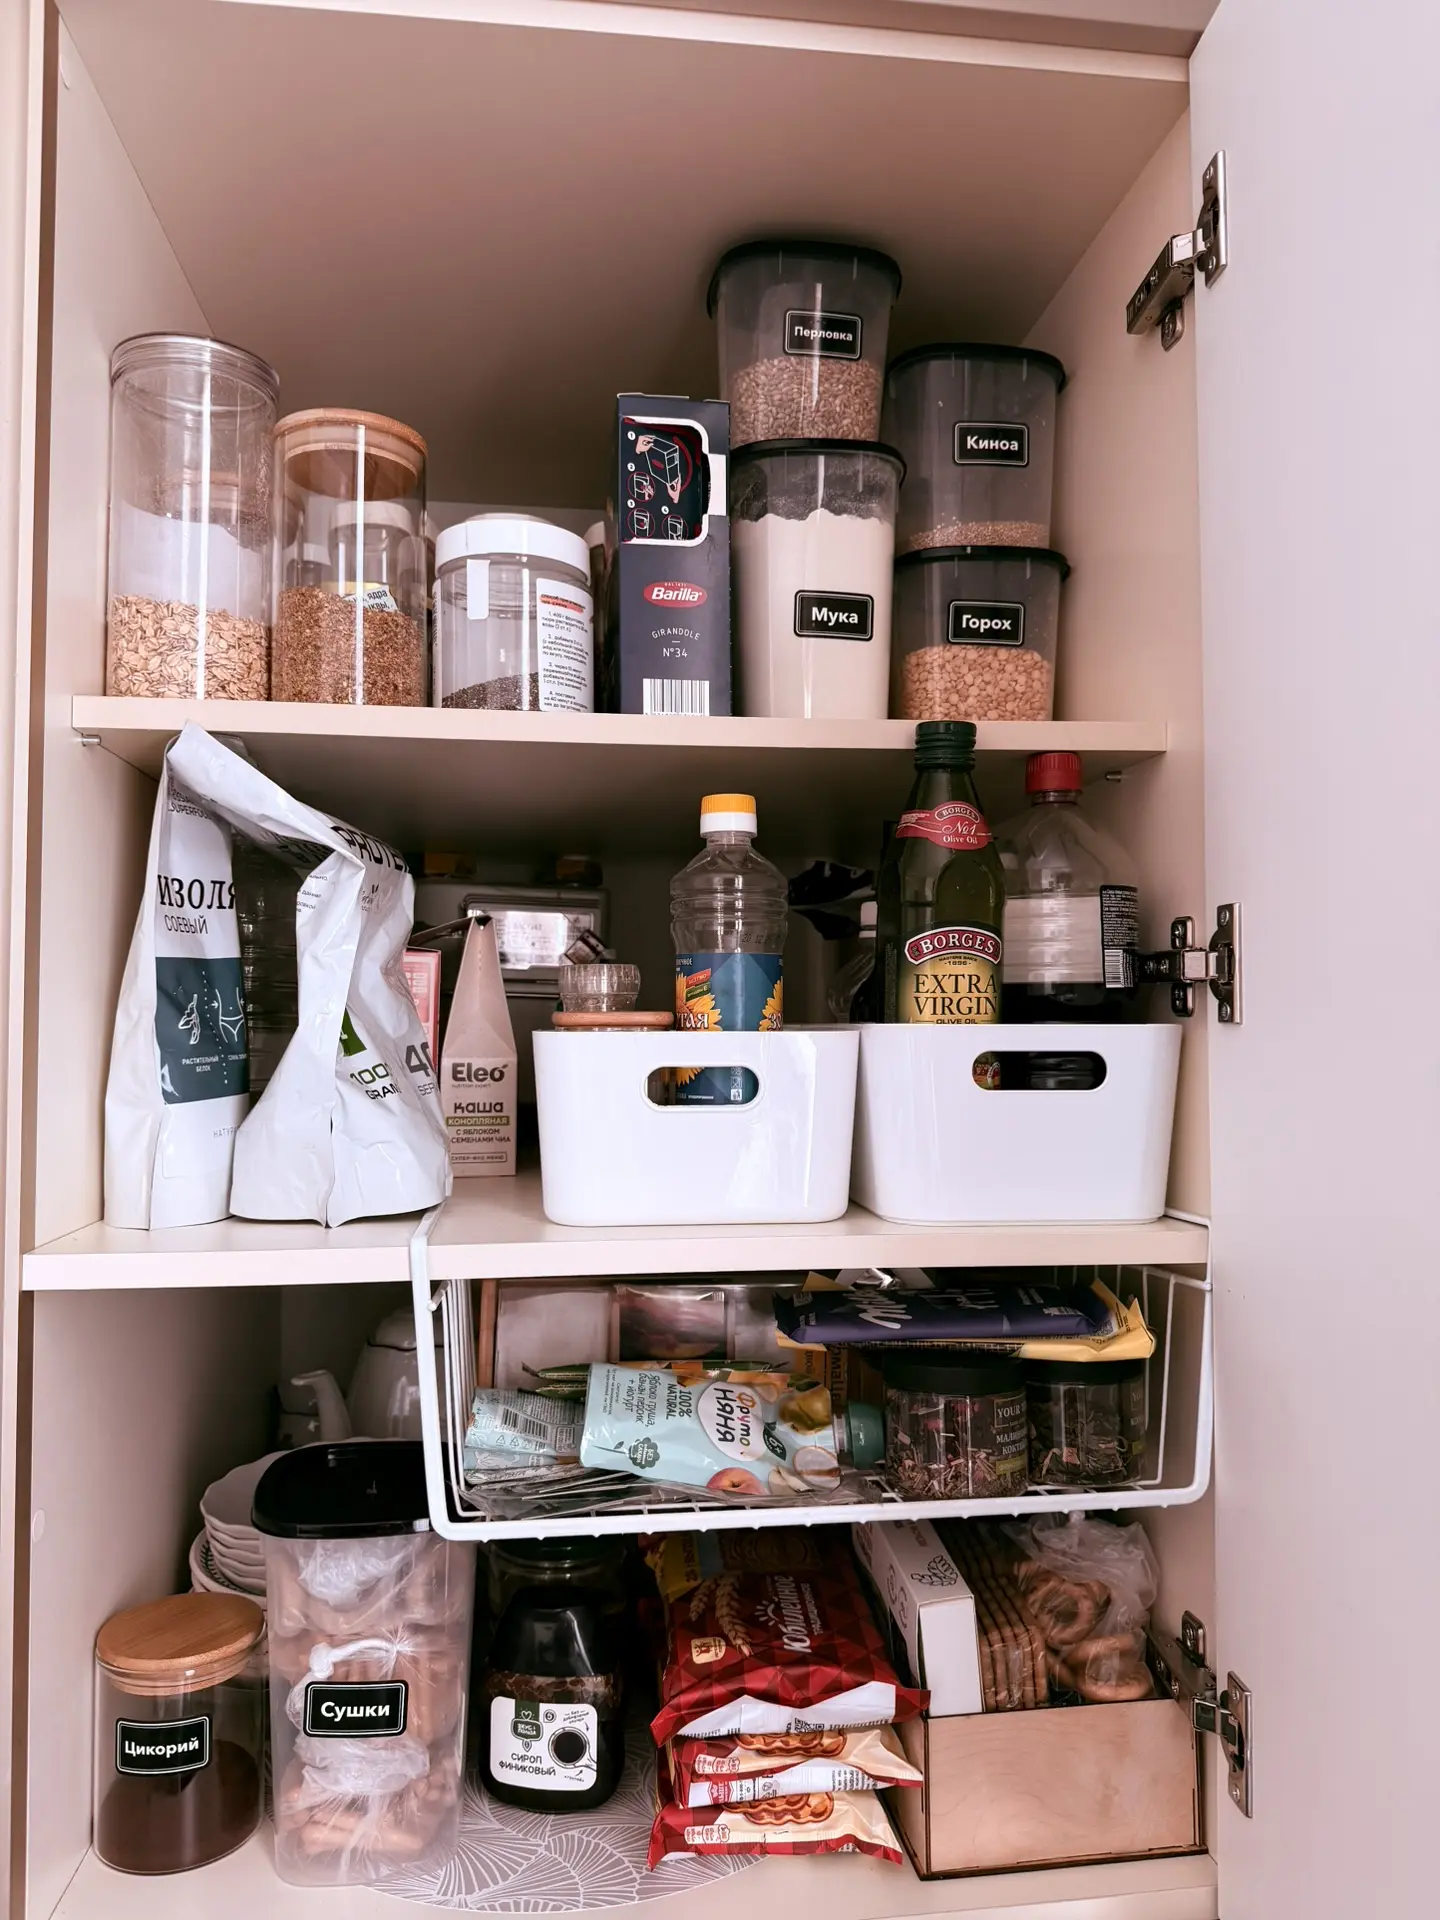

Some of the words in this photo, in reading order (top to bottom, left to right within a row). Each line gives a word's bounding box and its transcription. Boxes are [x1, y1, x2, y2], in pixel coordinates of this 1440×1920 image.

[794, 326, 853, 342] Перловка
[967, 435, 1018, 451] Киноа
[652, 587, 699, 601] Barilla
[811, 606, 859, 628] Мука
[962, 614, 1012, 632] Горох
[651, 627, 700, 641] GIRANDOLE
[942, 806, 976, 819] BORGES
[943, 835, 964, 844] Olive
[164, 914, 208, 934] СОЕВЫЙ
[919, 933, 995, 954] BORGES
[914, 973, 997, 994] EXTRA
[914, 996, 997, 1016] VIRGIN
[454, 1102, 504, 1114] каша
[448, 1117, 508, 1125] КОНОПЛЯНАЯ
[463, 1128, 500, 1136] ЯБЛОКОМ
[622, 1385, 635, 1412] йогурт
[665, 1383, 677, 1420] NATURAL
[678, 1390, 693, 1418] 100%
[713, 1387, 737, 1443] НЯНЯ
[997, 1405, 1021, 1418] YOUR
[773, 1575, 812, 1653] Юбилейное
[320, 1701, 391, 1722] Сушки
[124, 1737, 199, 1758] Цикорий
[511, 1752, 542, 1764] СИРОП
[498, 1760, 556, 1776] ФИНИКОВЫЙ
